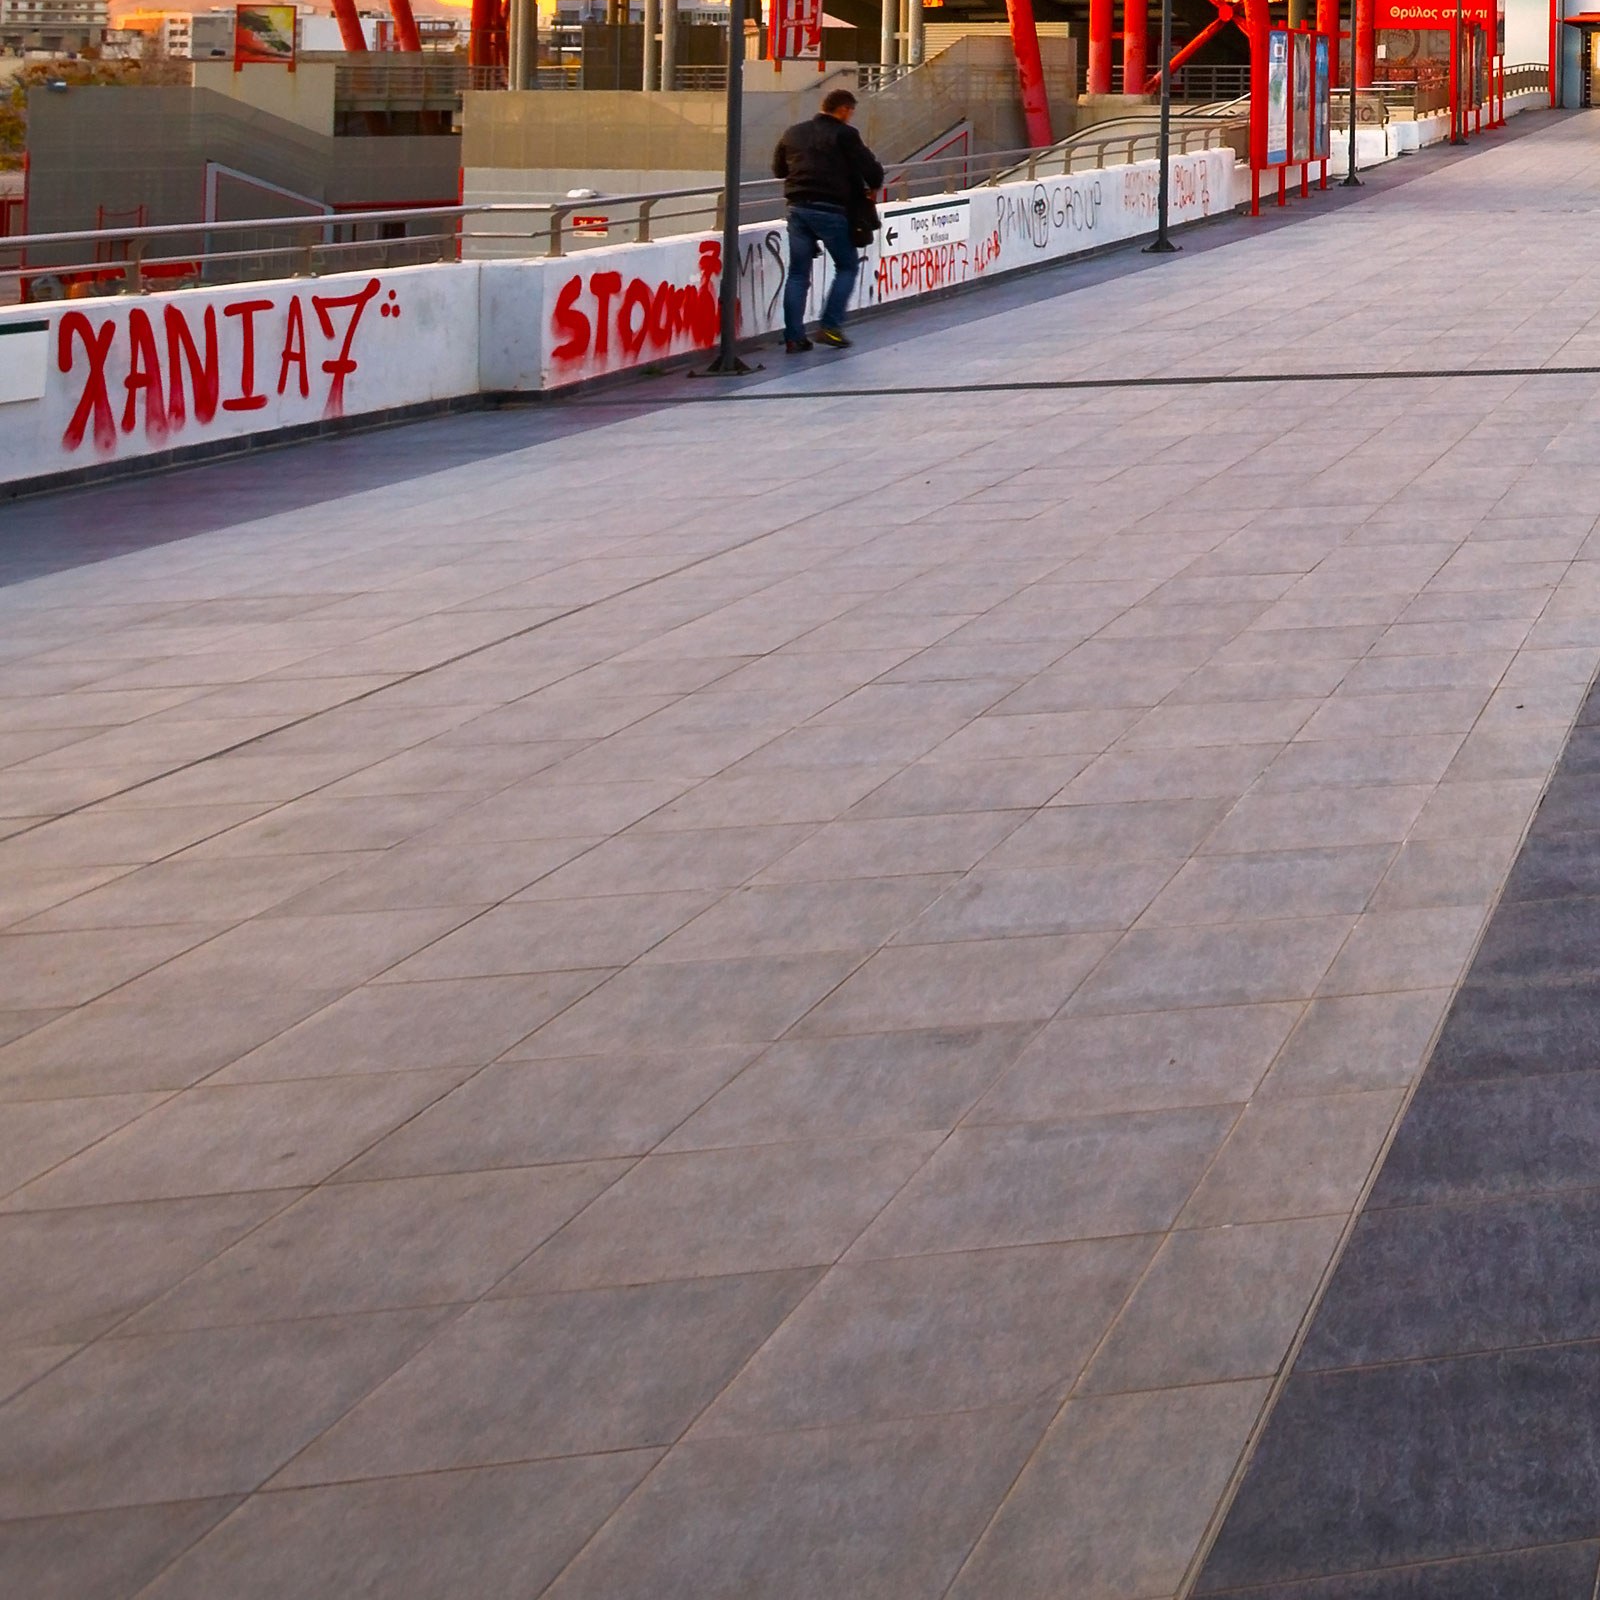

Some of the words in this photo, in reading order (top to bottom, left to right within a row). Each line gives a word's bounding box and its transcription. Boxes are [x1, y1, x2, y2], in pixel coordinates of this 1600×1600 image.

[1390, 6, 1437, 20] Θρύλος
[1051, 181, 1102, 232] GROUP
[910, 217, 929, 231] Προς
[932, 210, 960, 226] Κηφισιά
